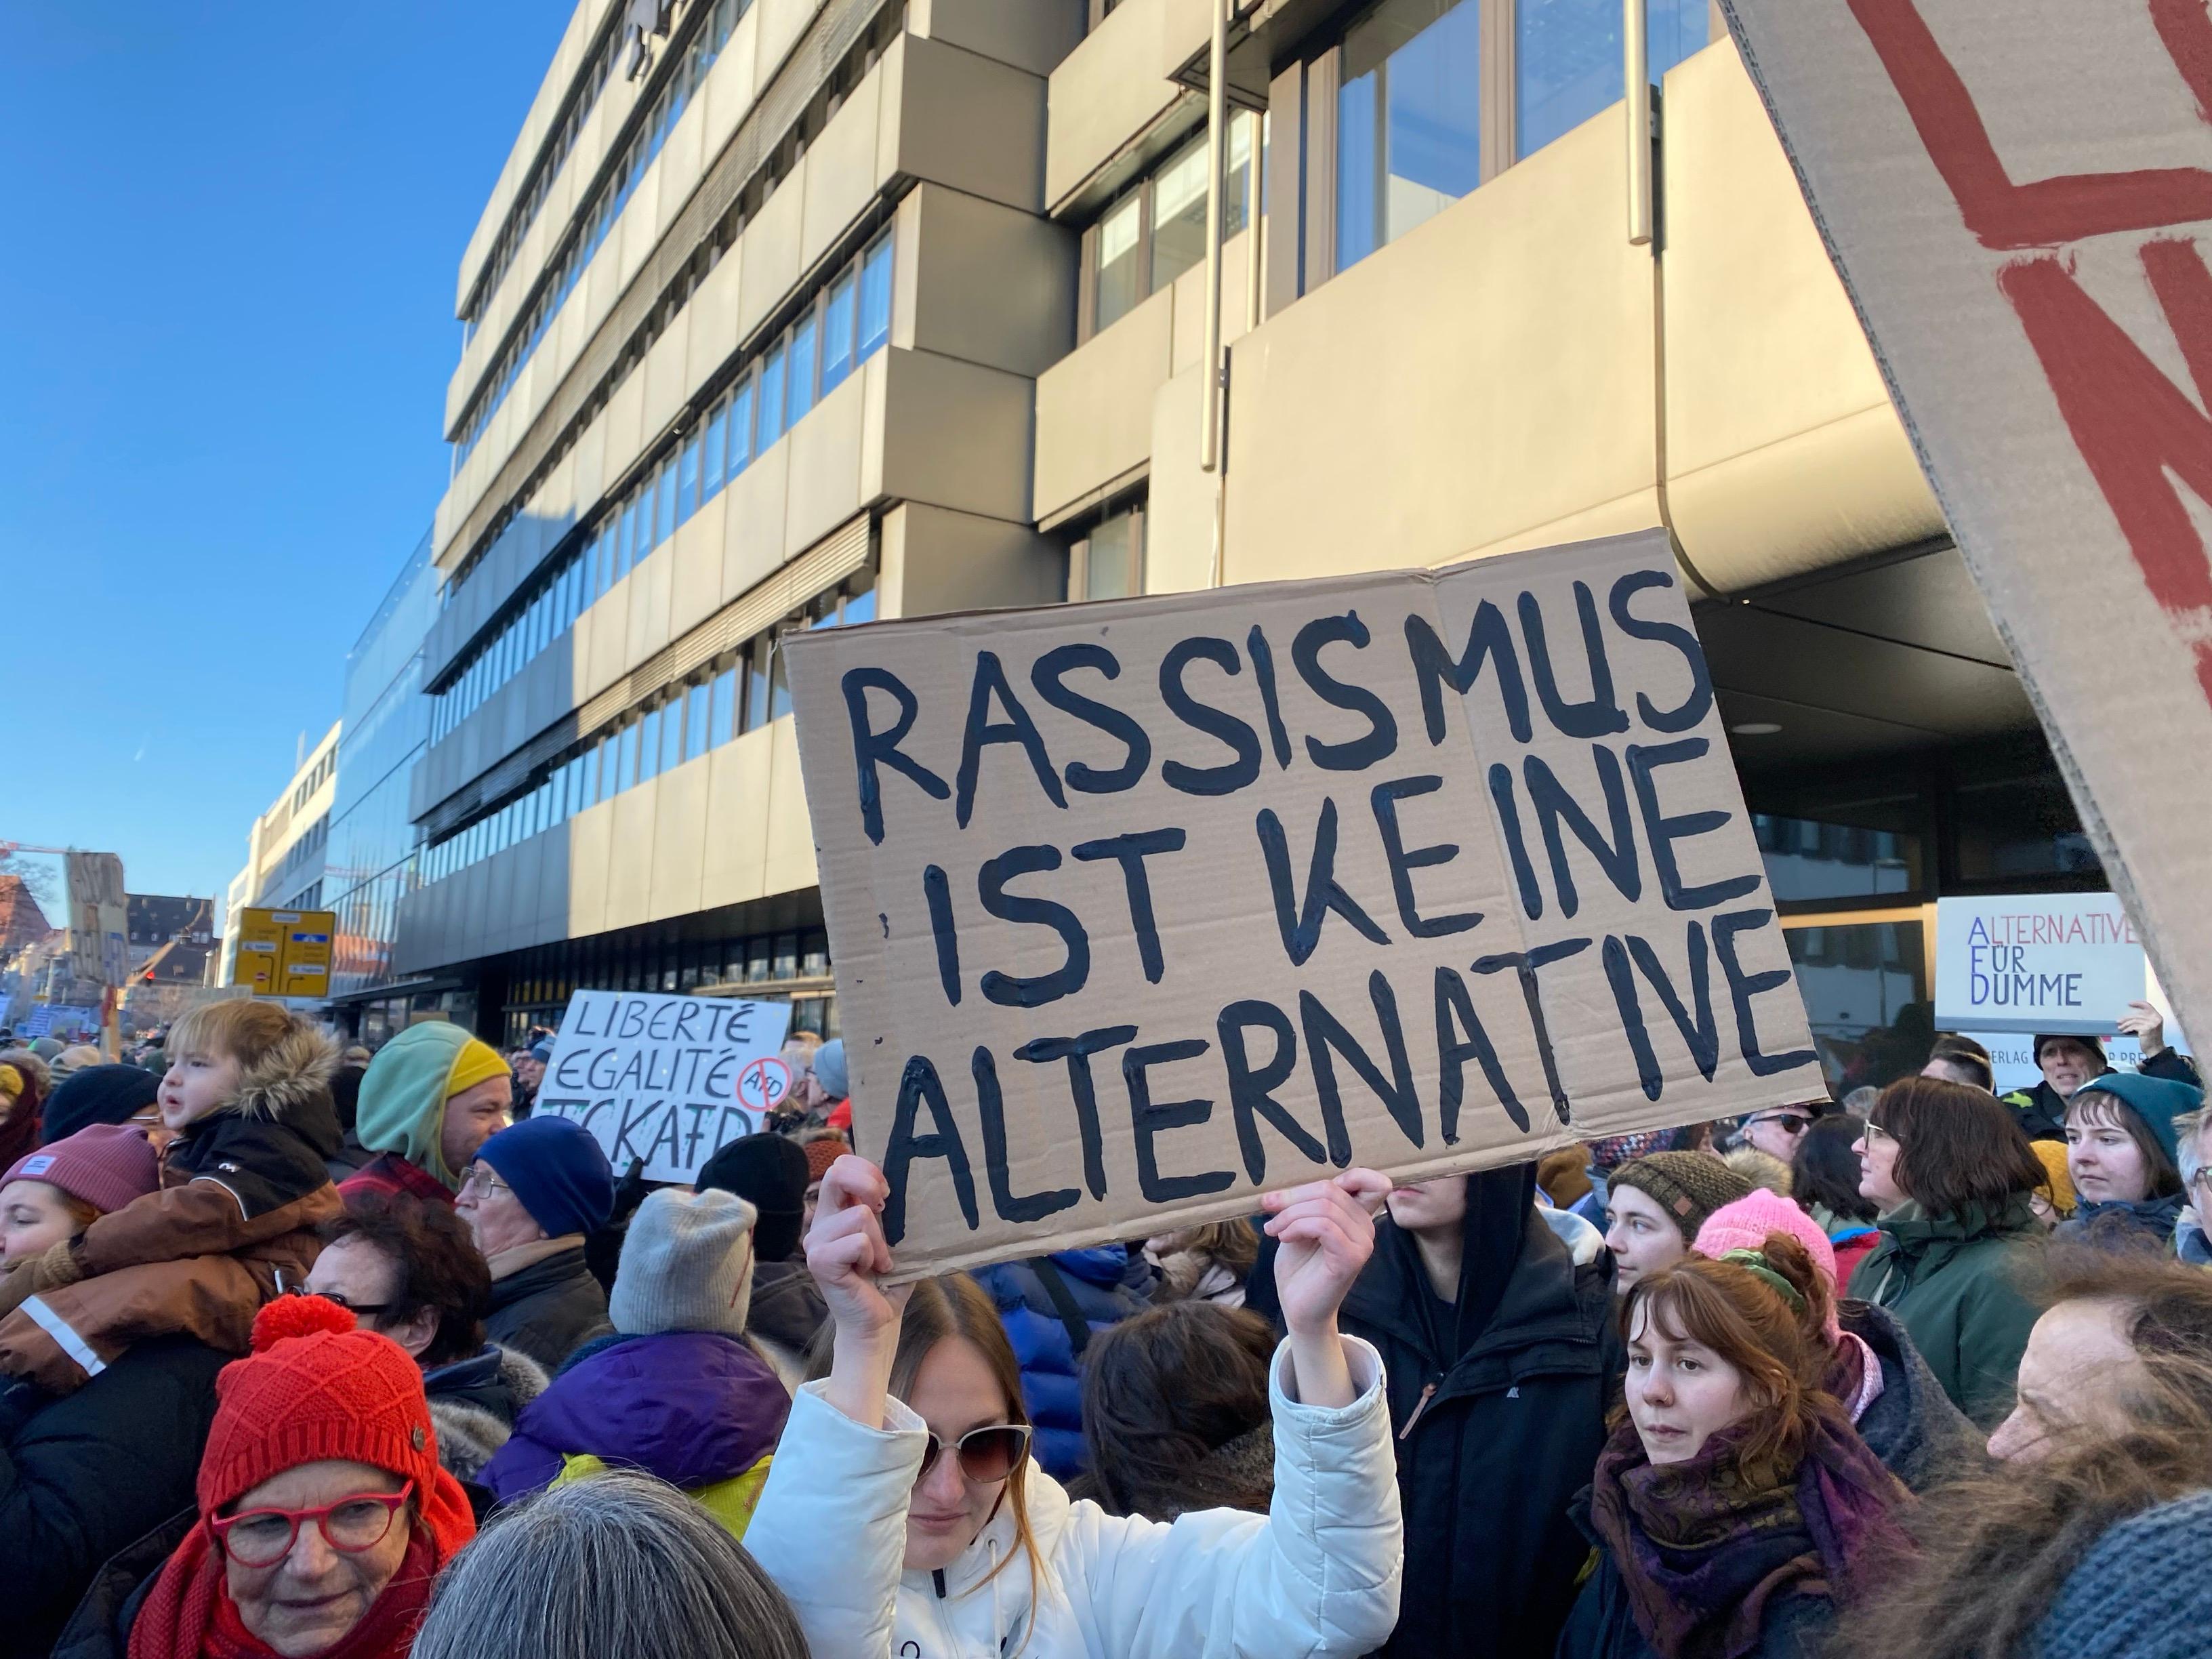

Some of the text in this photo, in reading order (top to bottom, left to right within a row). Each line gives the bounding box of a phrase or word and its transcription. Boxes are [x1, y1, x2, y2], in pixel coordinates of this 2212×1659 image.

[842, 570, 1713, 845] RASSISMUS
[924, 737, 1763, 1008] IST KEINE
[1971, 945, 2027, 973] FÜR
[1971, 973, 2083, 1006] DUMME
[574, 1001, 756, 1044] LIBERTÉ
[556, 1048, 737, 1099] EGALITÉ
[881, 909, 1819, 1246] ALTERNATIVE
[1990, 1050, 2028, 1064] ERLAG
